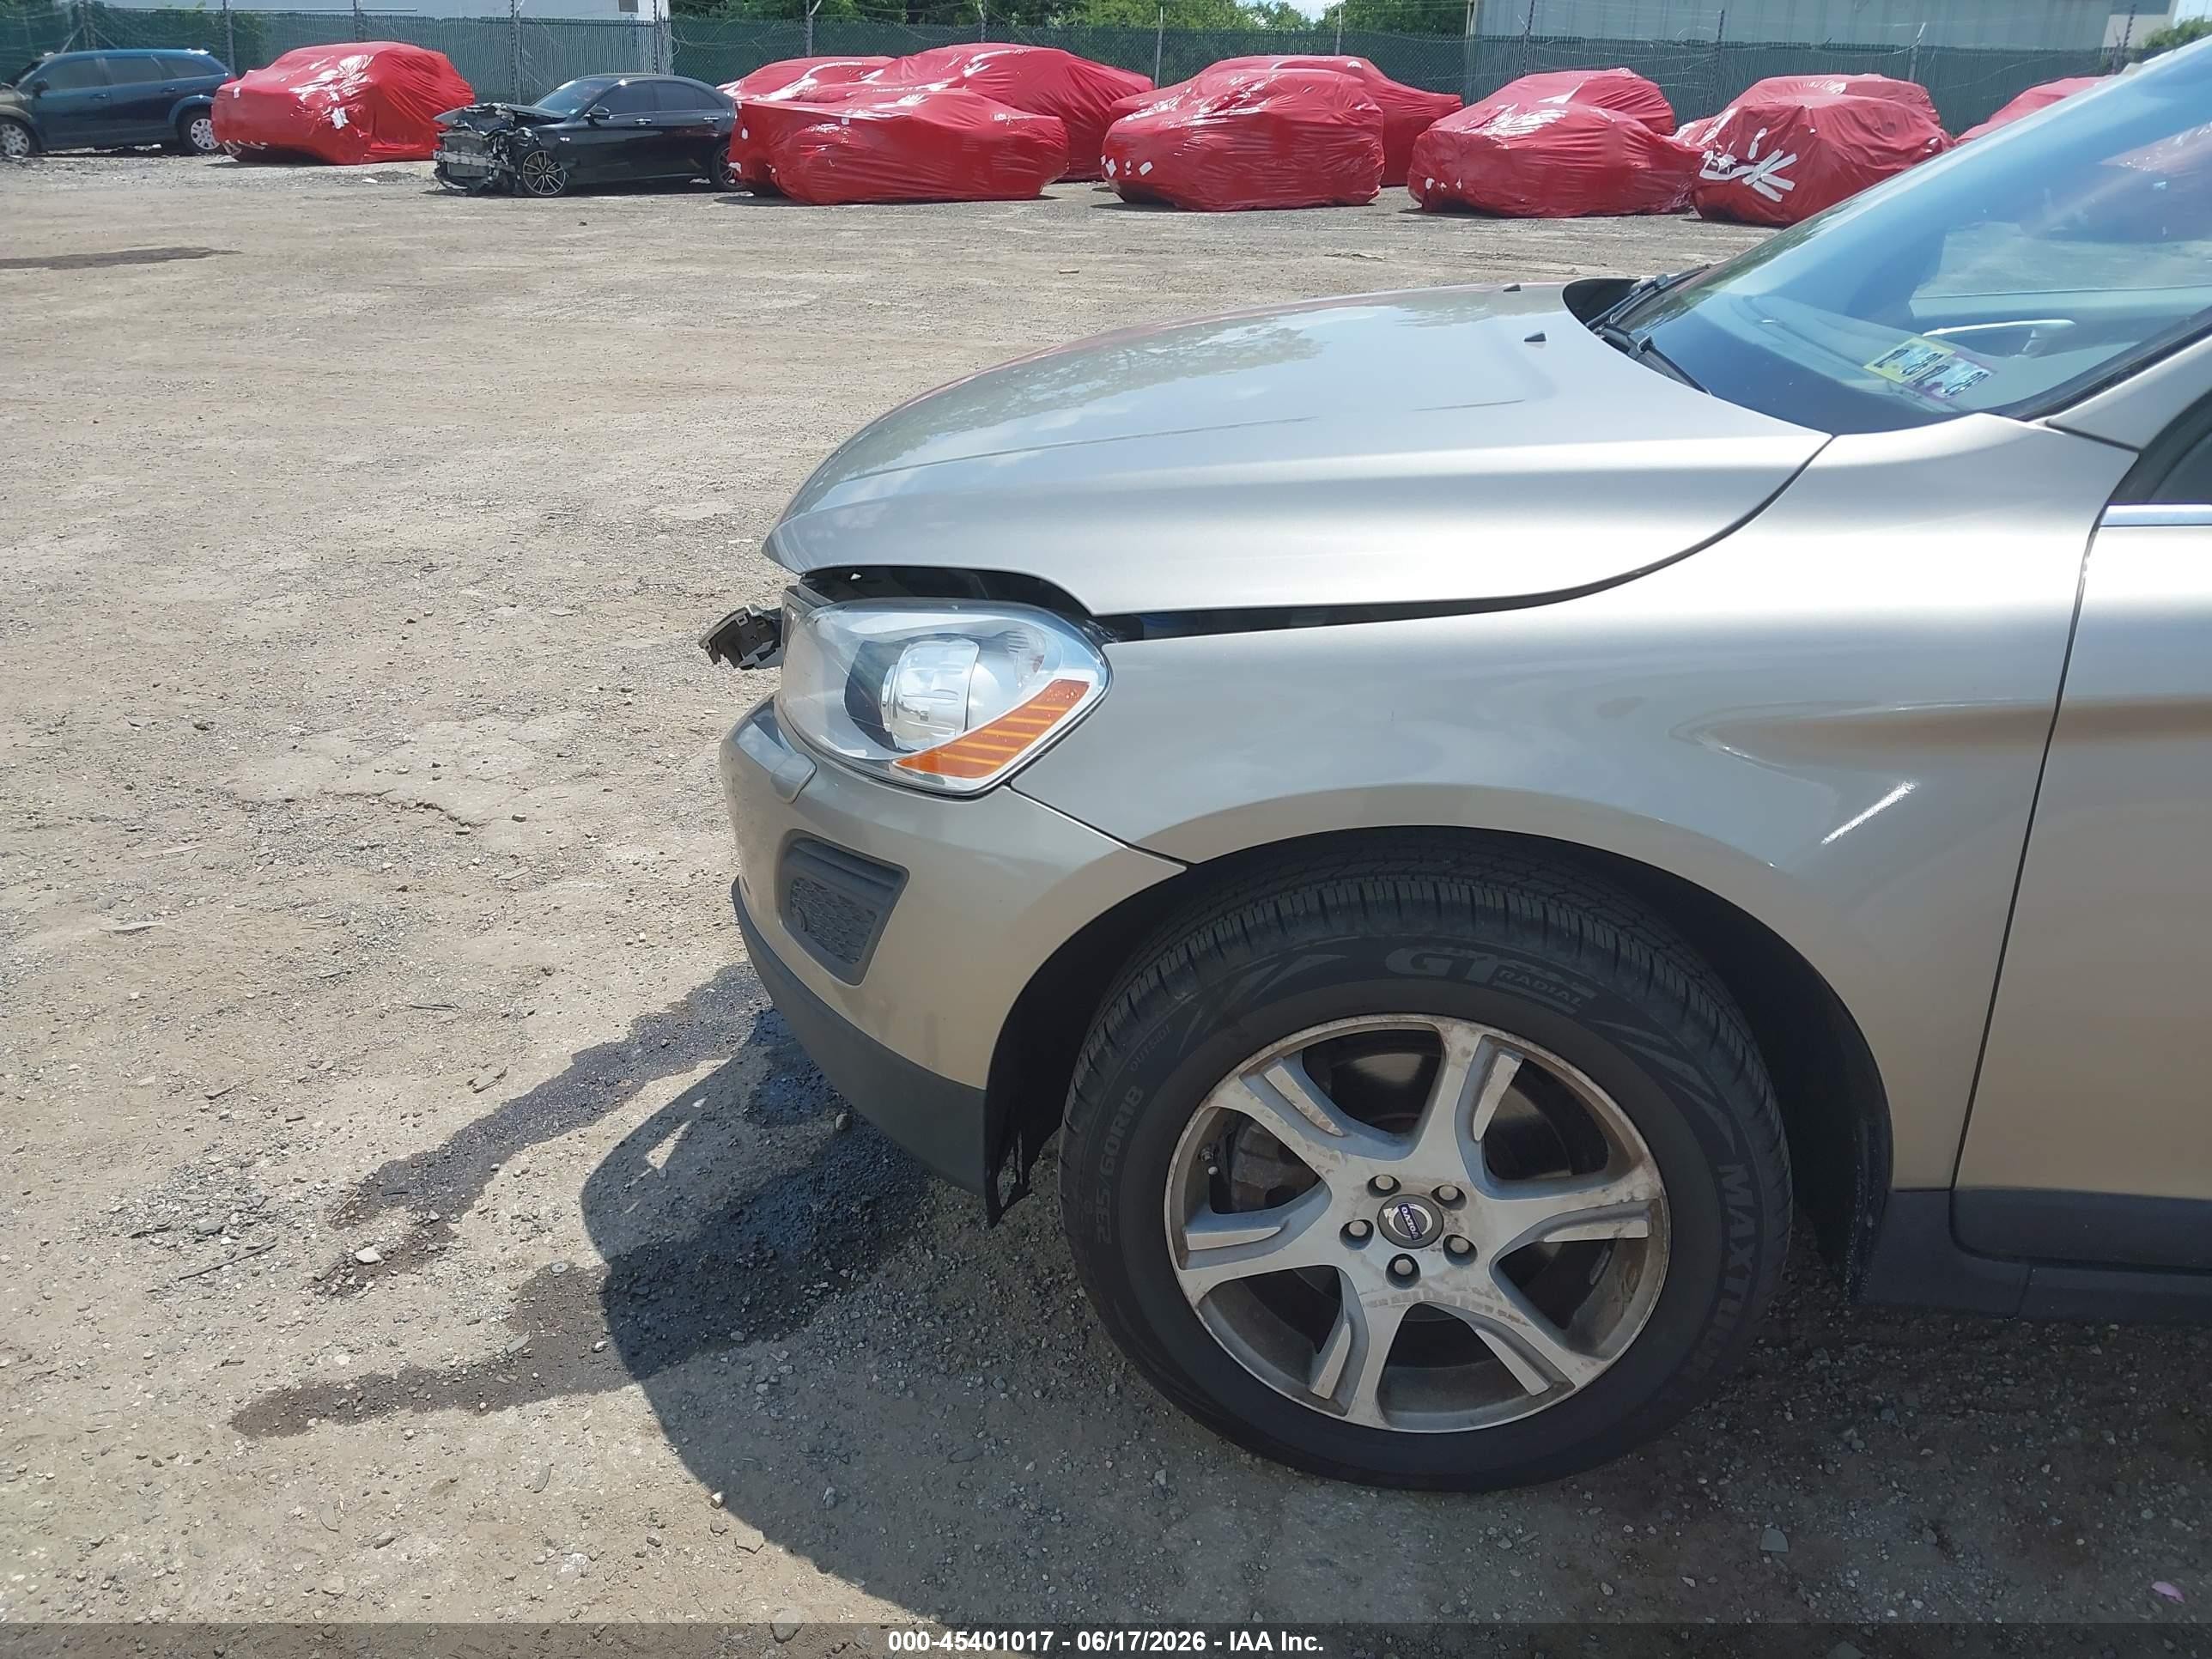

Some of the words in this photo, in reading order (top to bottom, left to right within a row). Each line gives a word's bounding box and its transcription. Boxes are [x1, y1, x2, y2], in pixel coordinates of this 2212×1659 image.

[1385, 947, 1499, 983] GT
[1498, 969, 1582, 1007] RADIAL
[1095, 1085, 1145, 1244] 235/60R18
[1401, 1206, 1419, 1238] VOLVO
